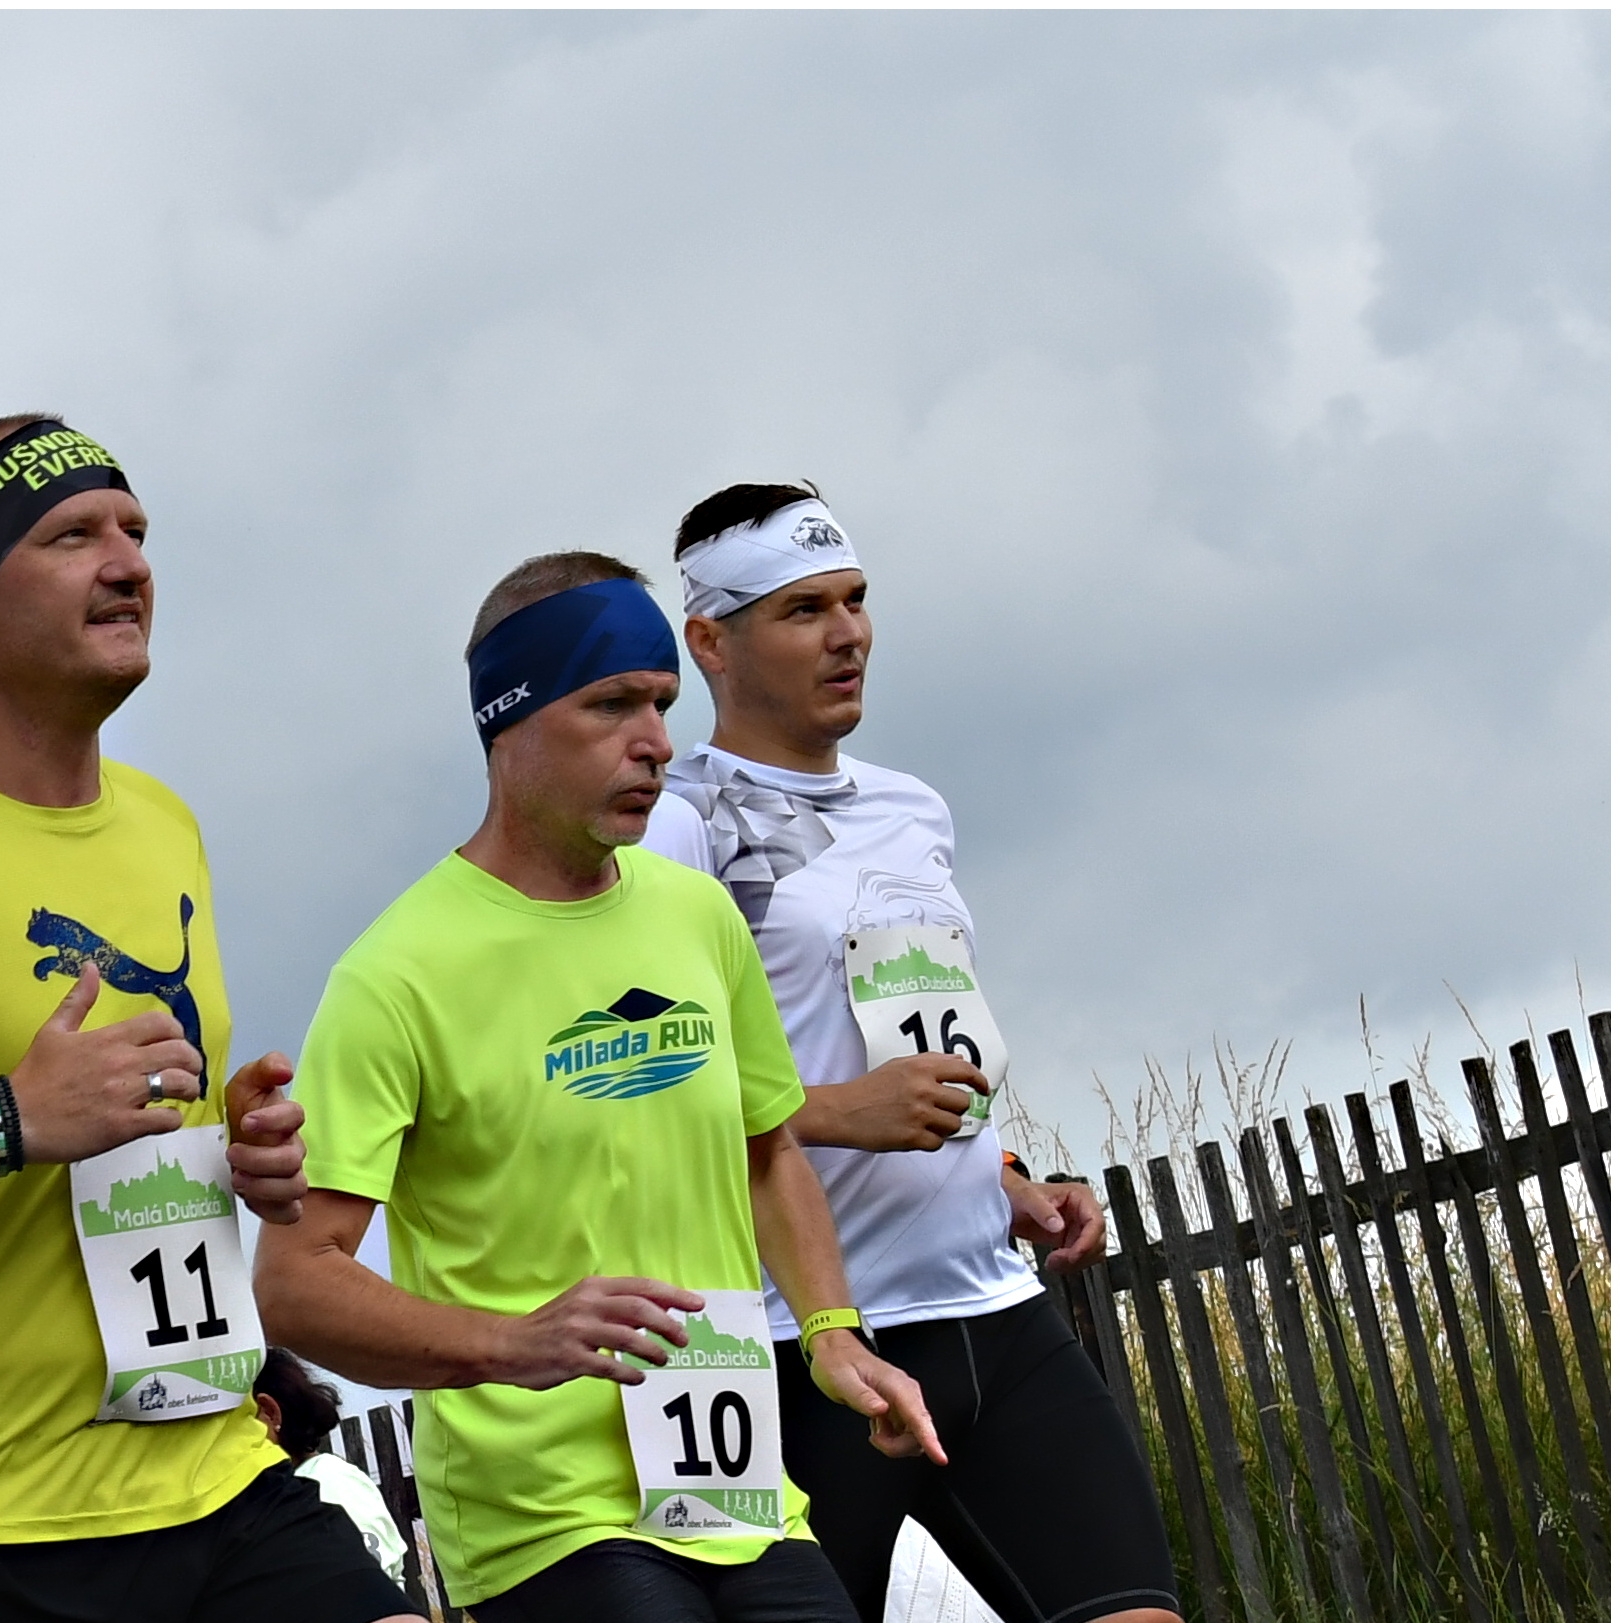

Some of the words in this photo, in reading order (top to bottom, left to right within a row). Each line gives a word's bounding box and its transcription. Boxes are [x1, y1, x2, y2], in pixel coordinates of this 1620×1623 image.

[876, 976, 918, 998] Malá
[919, 974, 966, 991] Dubická
[545, 1030, 649, 1082] Milada
[659, 1020, 716, 1051] RUN
[898, 1008, 982, 1071] 16
[113, 1206, 162, 1230] Malá
[166, 1195, 222, 1221] Dubická
[129, 1240, 229, 1347] 11
[668, 1348, 691, 1367] alá
[694, 1349, 759, 1367] Dubická
[663, 1390, 752, 1478] 10
